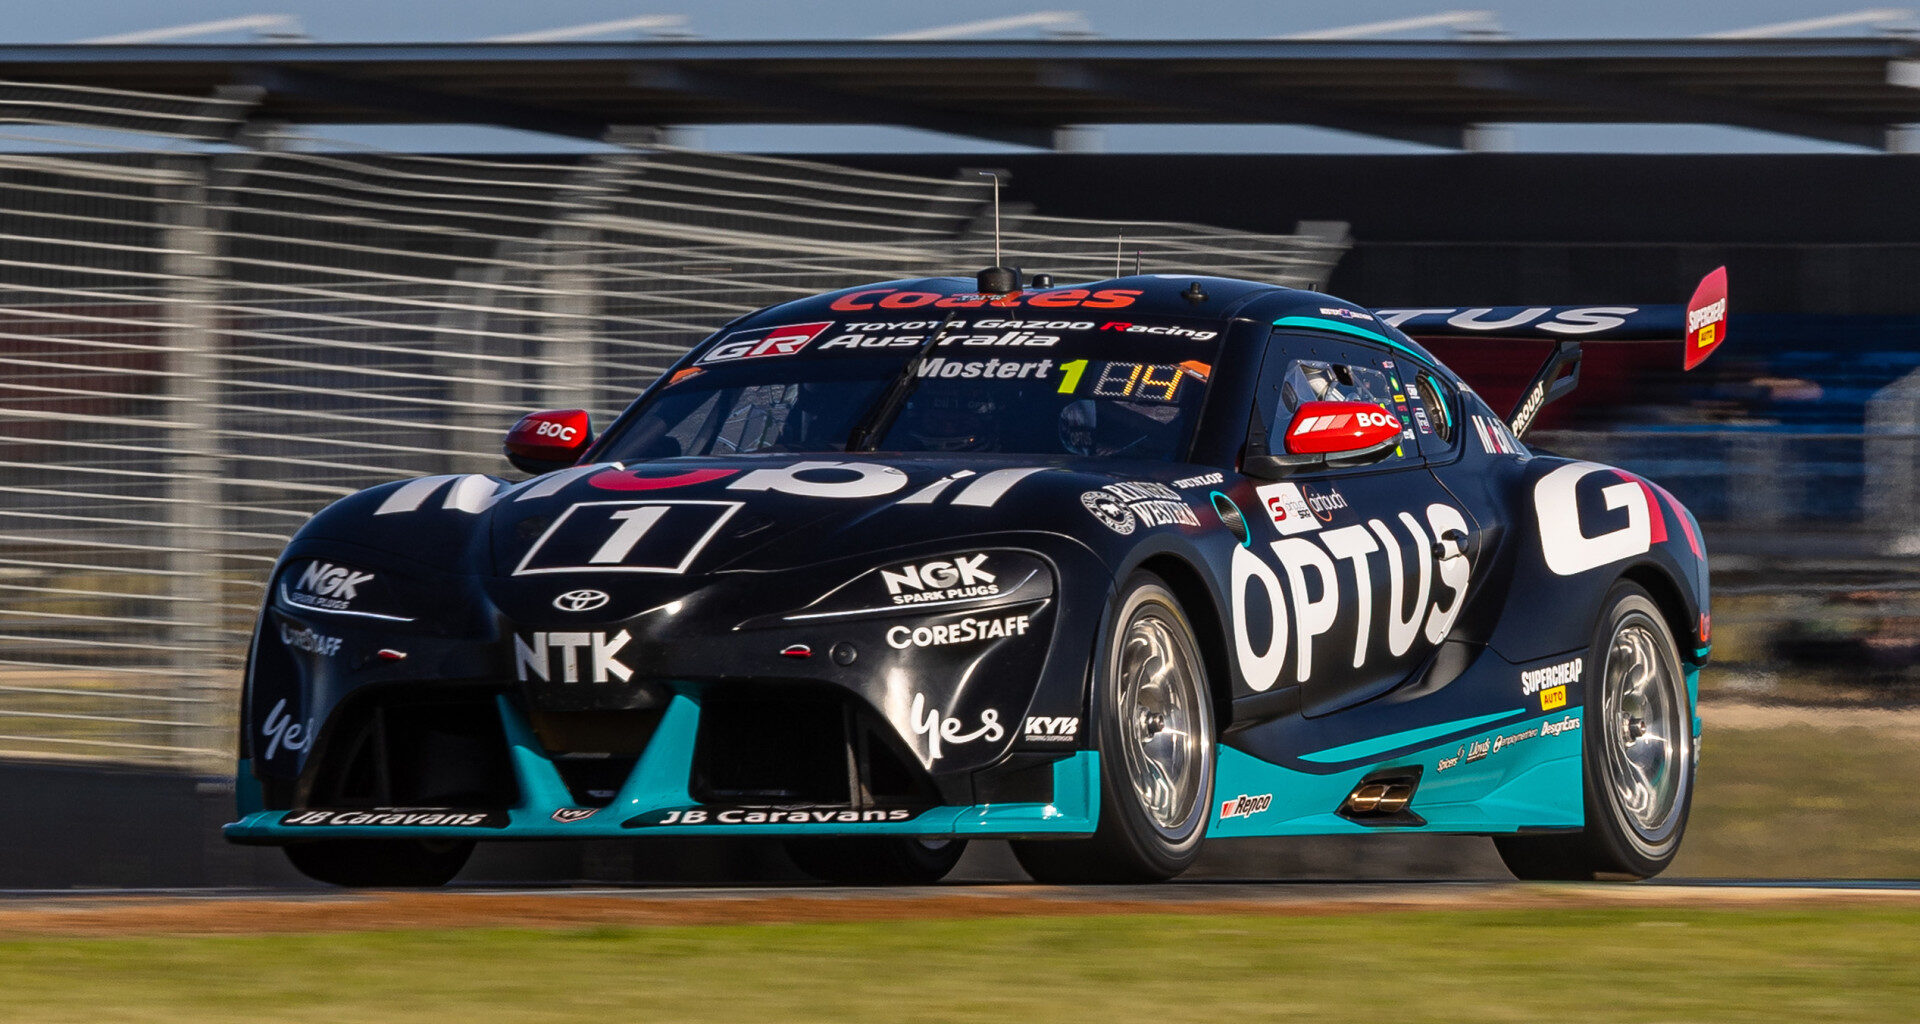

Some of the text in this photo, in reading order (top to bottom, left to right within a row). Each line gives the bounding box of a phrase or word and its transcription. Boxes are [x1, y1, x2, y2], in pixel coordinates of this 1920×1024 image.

[1375, 306, 1639, 335] TUS
[1689, 298, 1726, 333] SUPERCHEAP
[817, 331, 1061, 350] Australia
[845, 318, 1218, 341] TOYOTA GAZOO Racing
[704, 335, 810, 361] GR
[916, 357, 1053, 379] Mostert
[1057, 359, 1089, 394] 1
[536, 421, 577, 441] BOC
[1356, 412, 1399, 429] BOC
[1178, 472, 1223, 489] DUNLOP
[1128, 500, 1201, 528] WESTERN
[588, 506, 671, 564] 1
[296, 560, 375, 600] NGK
[881, 554, 996, 596] NGK
[892, 584, 1000, 604] SPARK PLUGS
[1232, 503, 1470, 691] OPTUS
[513, 629, 634, 683] NTK
[1521, 658, 1582, 695] SUPERCHEAP
[1544, 691, 1564, 704] AUTO
[1024, 716, 1079, 734] KYB
[659, 807, 911, 824] JB Caravans
[1234, 795, 1271, 816] Repco
[284, 810, 489, 826] JB Caravans
